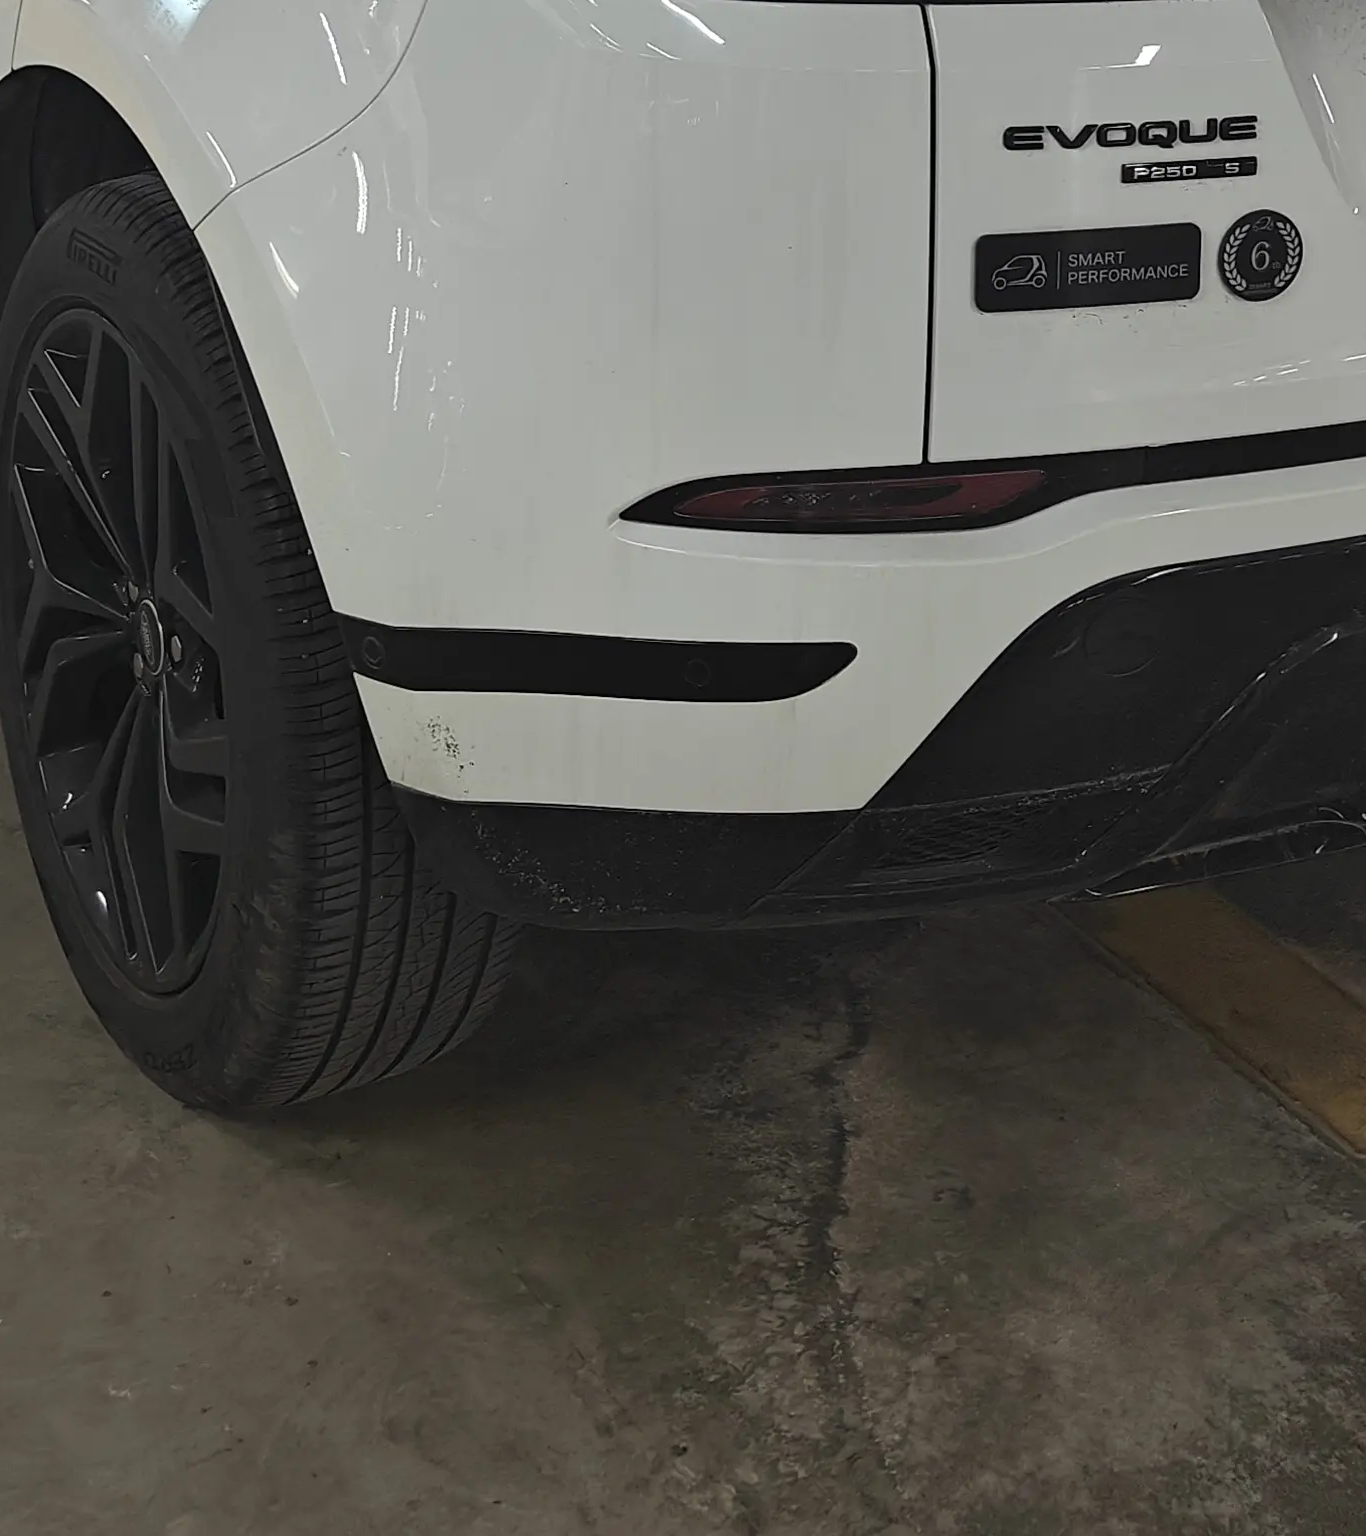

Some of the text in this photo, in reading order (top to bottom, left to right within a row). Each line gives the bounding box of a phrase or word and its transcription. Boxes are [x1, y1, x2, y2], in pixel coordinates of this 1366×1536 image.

[1002, 115, 1258, 151] EVOQUE
[1134, 162, 1240, 180] P250 S
[1067, 250, 1127, 268] SMART
[1251, 241, 1270, 270] 6
[1067, 264, 1189, 285] PERFORMANCE
